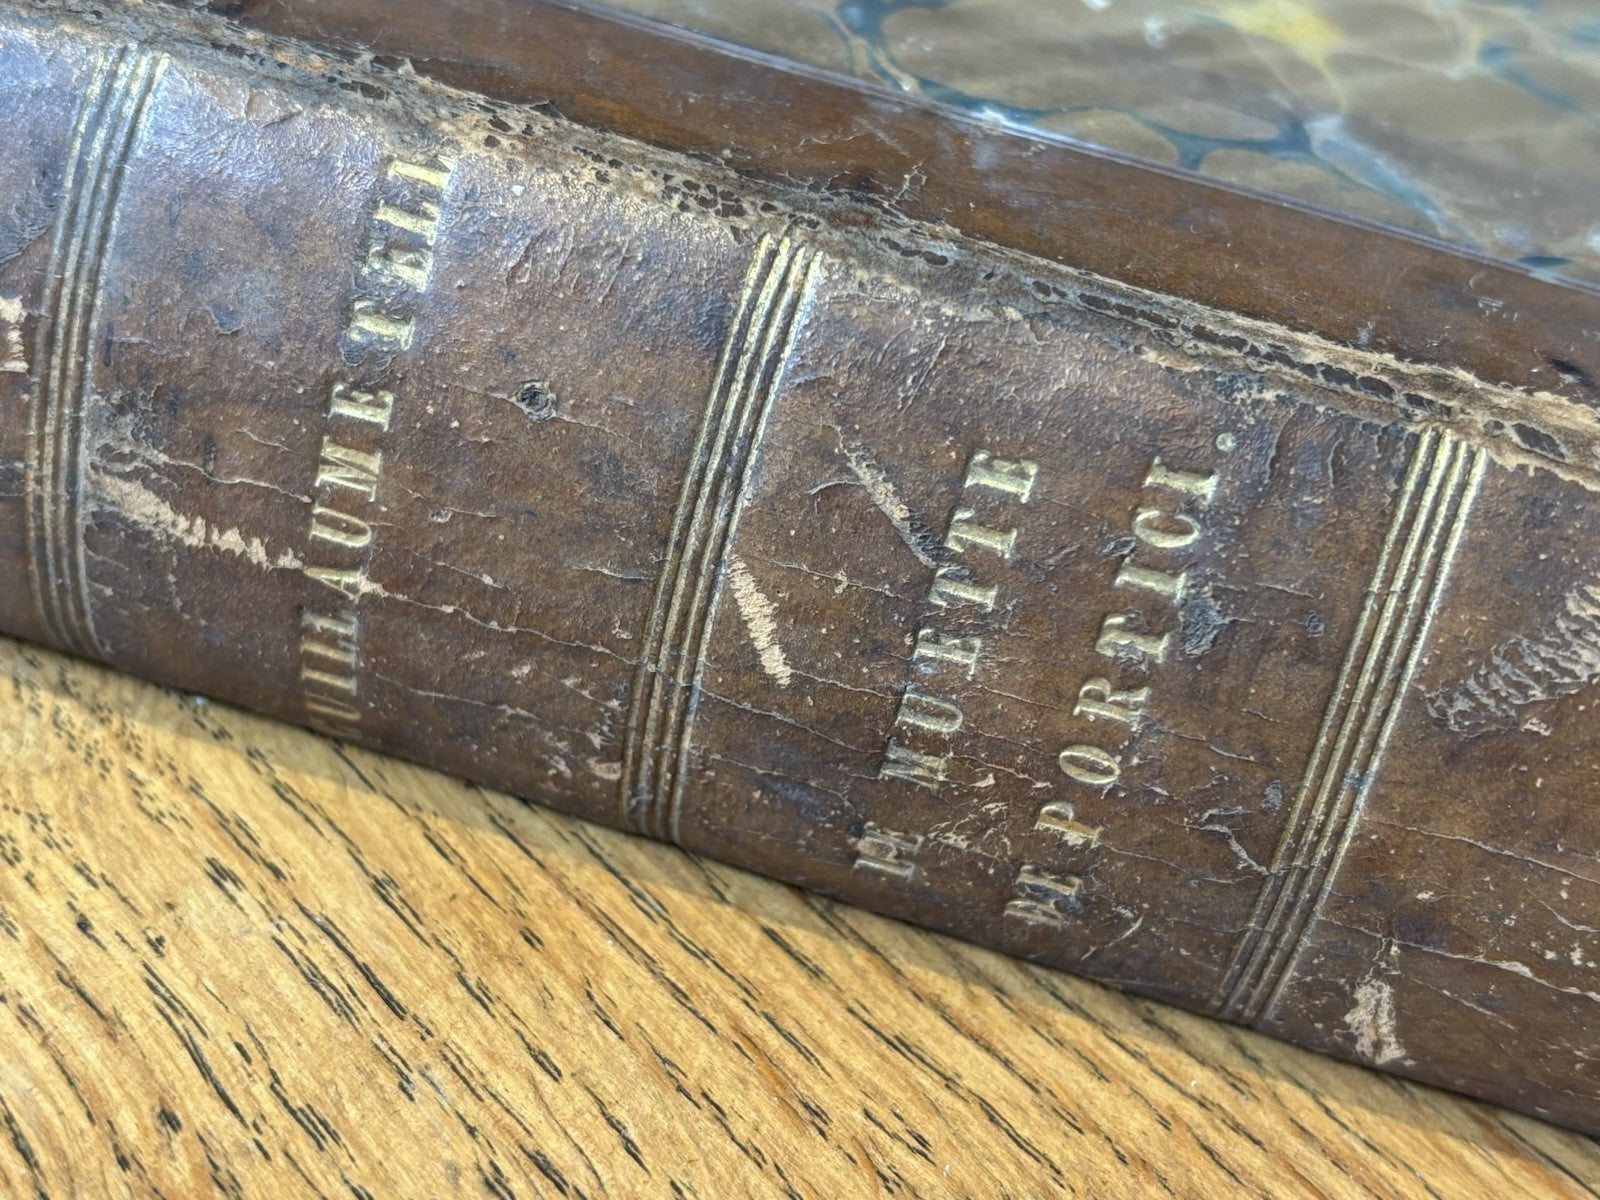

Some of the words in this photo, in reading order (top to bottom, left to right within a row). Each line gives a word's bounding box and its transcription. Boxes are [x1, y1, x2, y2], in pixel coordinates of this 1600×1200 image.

[349, 153, 457, 352] TELL
[878, 449, 1039, 793] MUETTE
[1034, 432, 1236, 848] PORTICI.
[1003, 865, 1085, 931] DE
